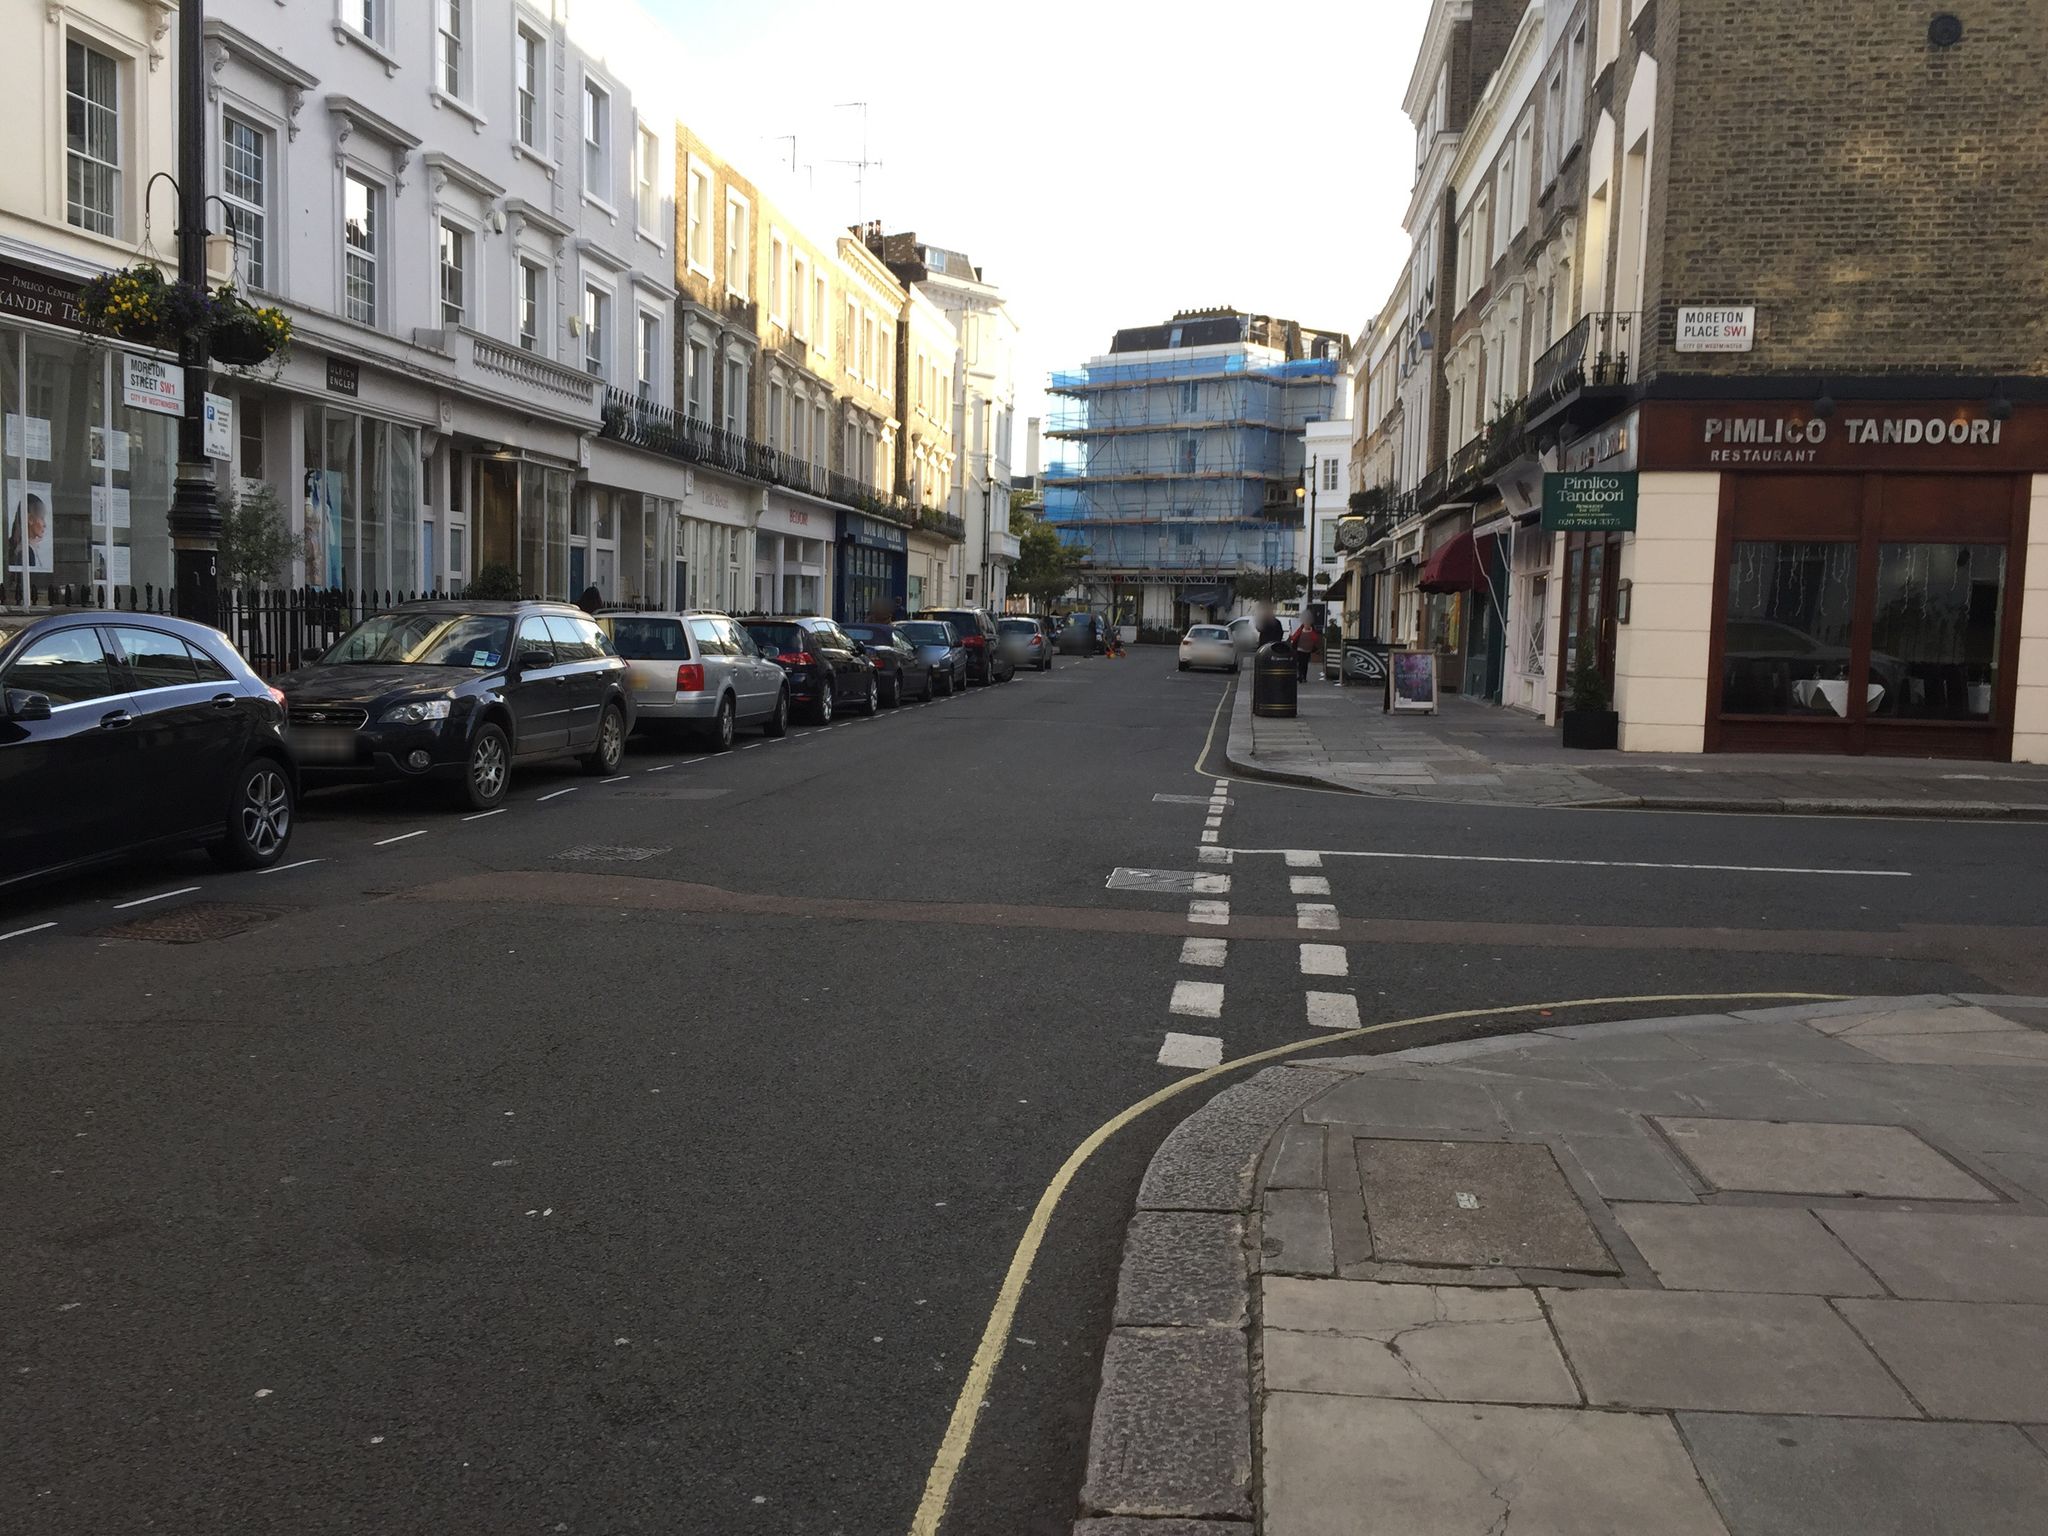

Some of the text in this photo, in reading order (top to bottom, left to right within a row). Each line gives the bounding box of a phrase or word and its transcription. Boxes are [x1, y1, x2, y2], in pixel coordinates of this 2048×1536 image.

[12, 275, 45, 294] PIMLICO
[1685, 311, 1744, 323] MORETON
[1684, 325, 1747, 337] PLACE SW1
[130, 358, 166, 379] MORETON
[130, 373, 176, 396] STREET SW1
[330, 375, 356, 390] ENGLER
[1704, 418, 2002, 445] PIMLICO TANDOORI
[1710, 449, 1816, 462] RESTAURANT
[1563, 476, 1619, 490] Pimlico
[1556, 488, 1625, 502] Tandoori
